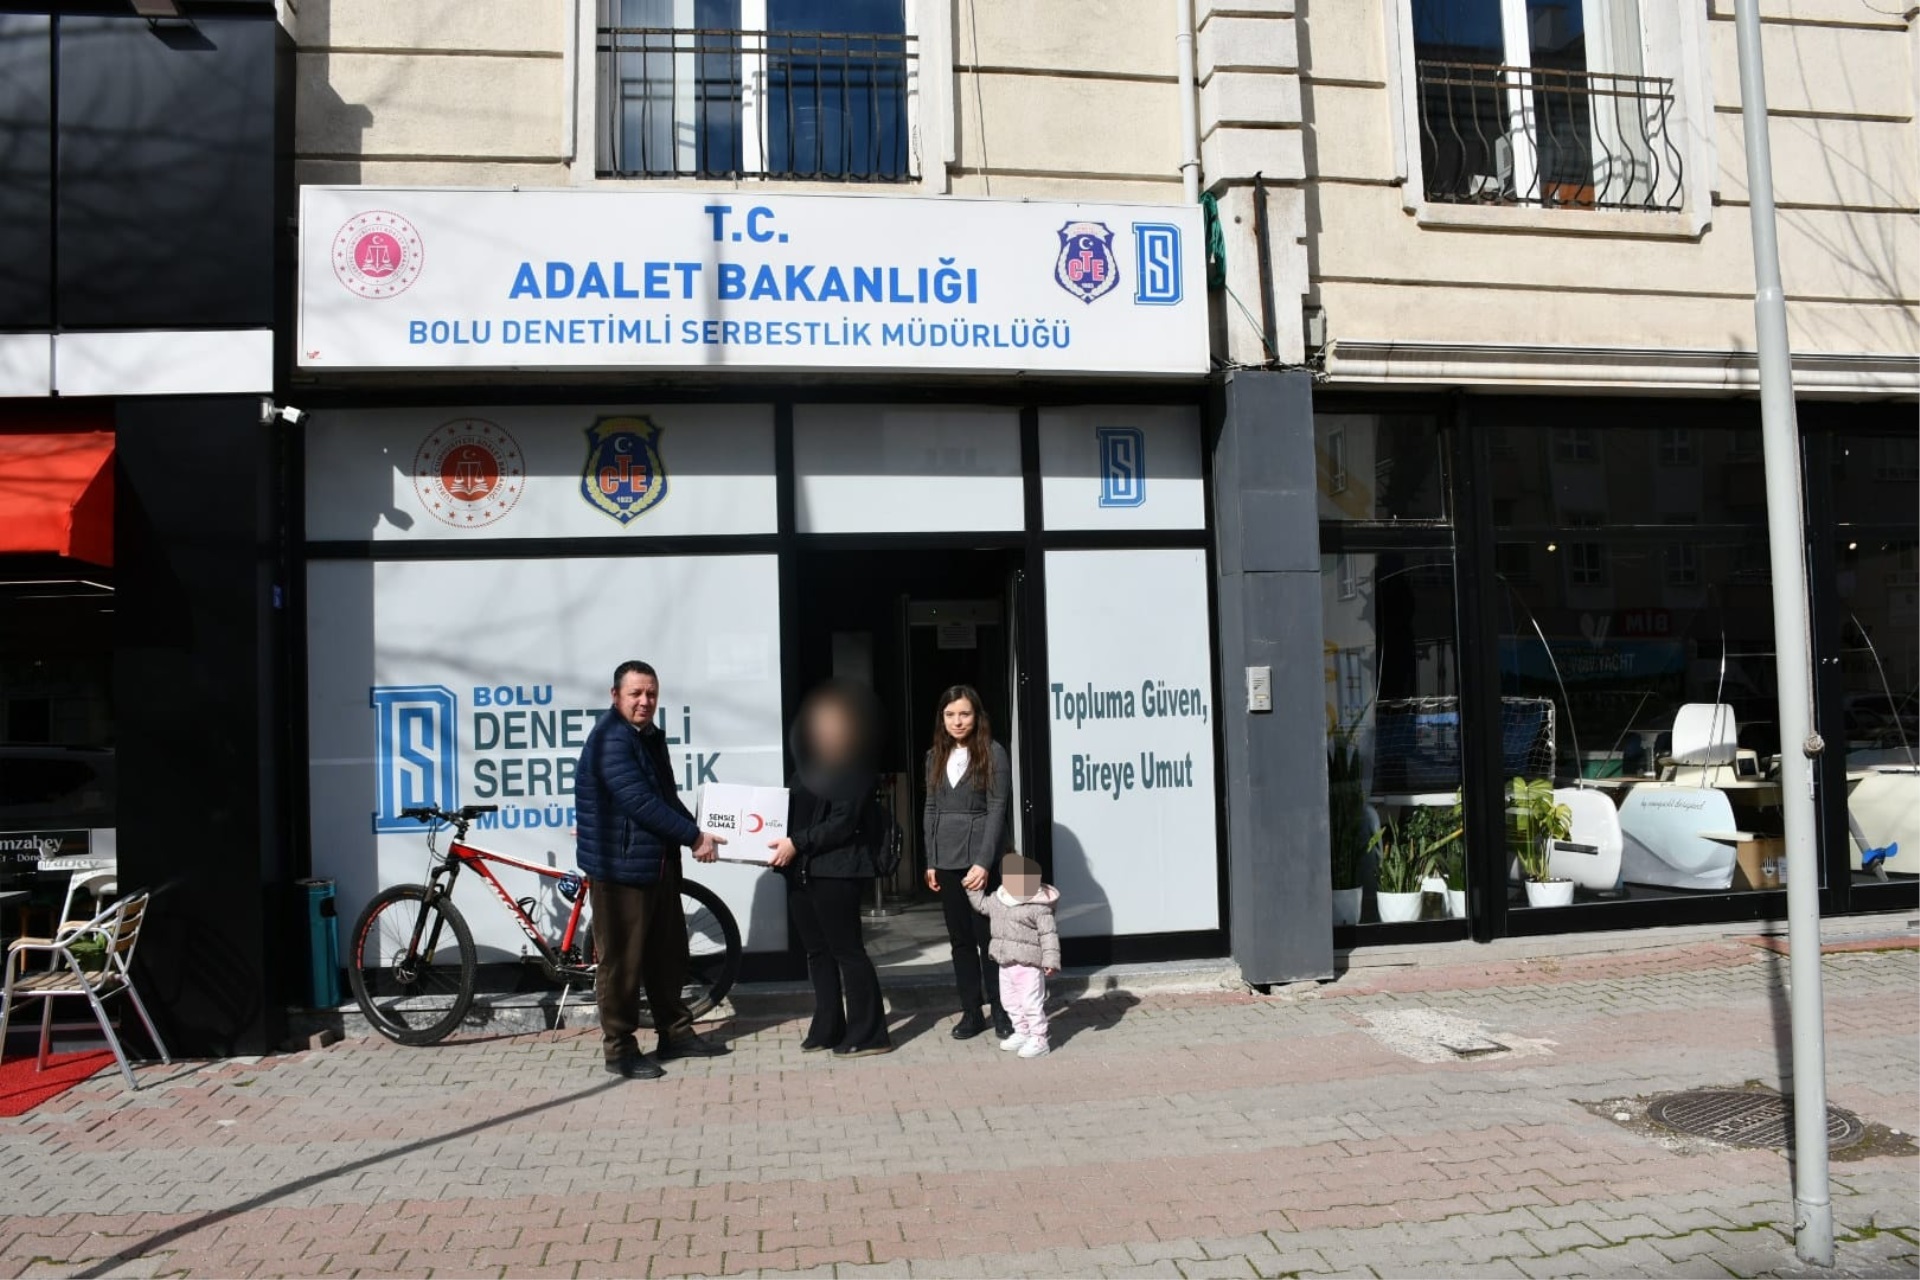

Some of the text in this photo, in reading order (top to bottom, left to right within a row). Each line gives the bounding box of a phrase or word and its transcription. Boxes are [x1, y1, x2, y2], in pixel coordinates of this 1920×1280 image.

[704, 203, 790, 244] T.C.
[508, 256, 978, 305] ADALET BAKANLIĞI
[1068, 250, 1105, 282] CTE
[408, 314, 1071, 350] BOLU DENETİMLİ SERBESTLİK MÜDÜRLÜĞÜ
[599, 454, 648, 495] CTE
[473, 684, 553, 707] BOLU
[1051, 679, 1208, 730] Topluma Güven,
[474, 705, 691, 750] DENETLİ
[474, 752, 720, 799] SERBİK
[1071, 751, 1193, 801] Bireye Umut
[706, 821, 735, 829] OLMAZ
[708, 813, 735, 822] SENSİZ
